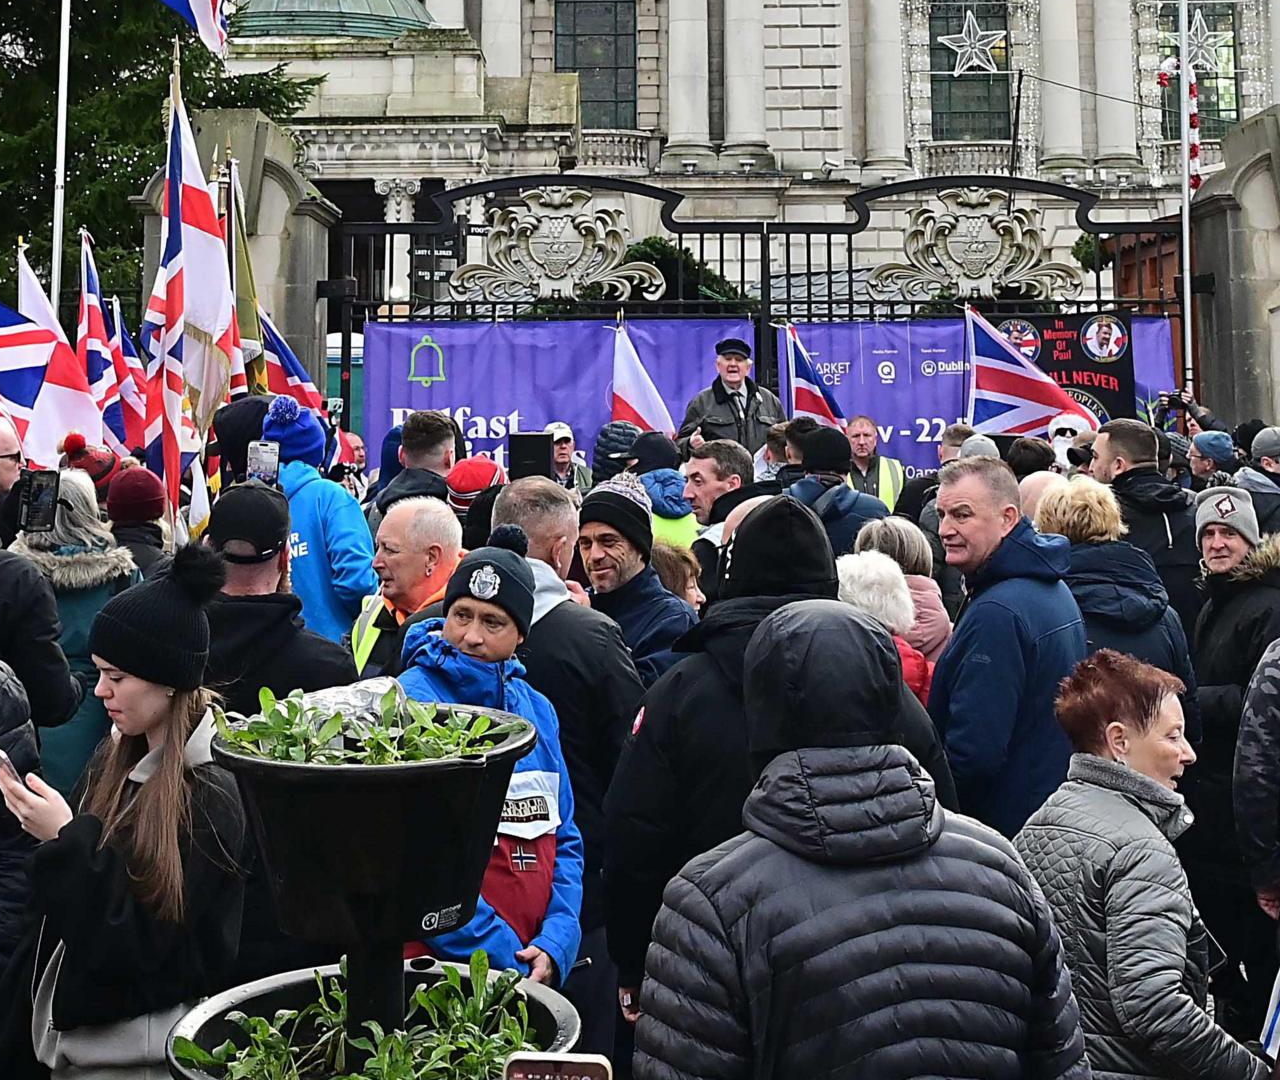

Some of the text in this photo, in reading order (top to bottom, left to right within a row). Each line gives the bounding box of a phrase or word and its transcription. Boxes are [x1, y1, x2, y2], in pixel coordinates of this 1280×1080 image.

[1055, 320, 1064, 329] In
[1043, 329, 1077, 341] Memory
[1053, 350, 1072, 360] Paul
[815, 362, 851, 375] ARKET
[1072, 370, 1120, 392] NEVER
[1068, 391, 1105, 418] EOPLES
[915, 418, 946, 442] 22
